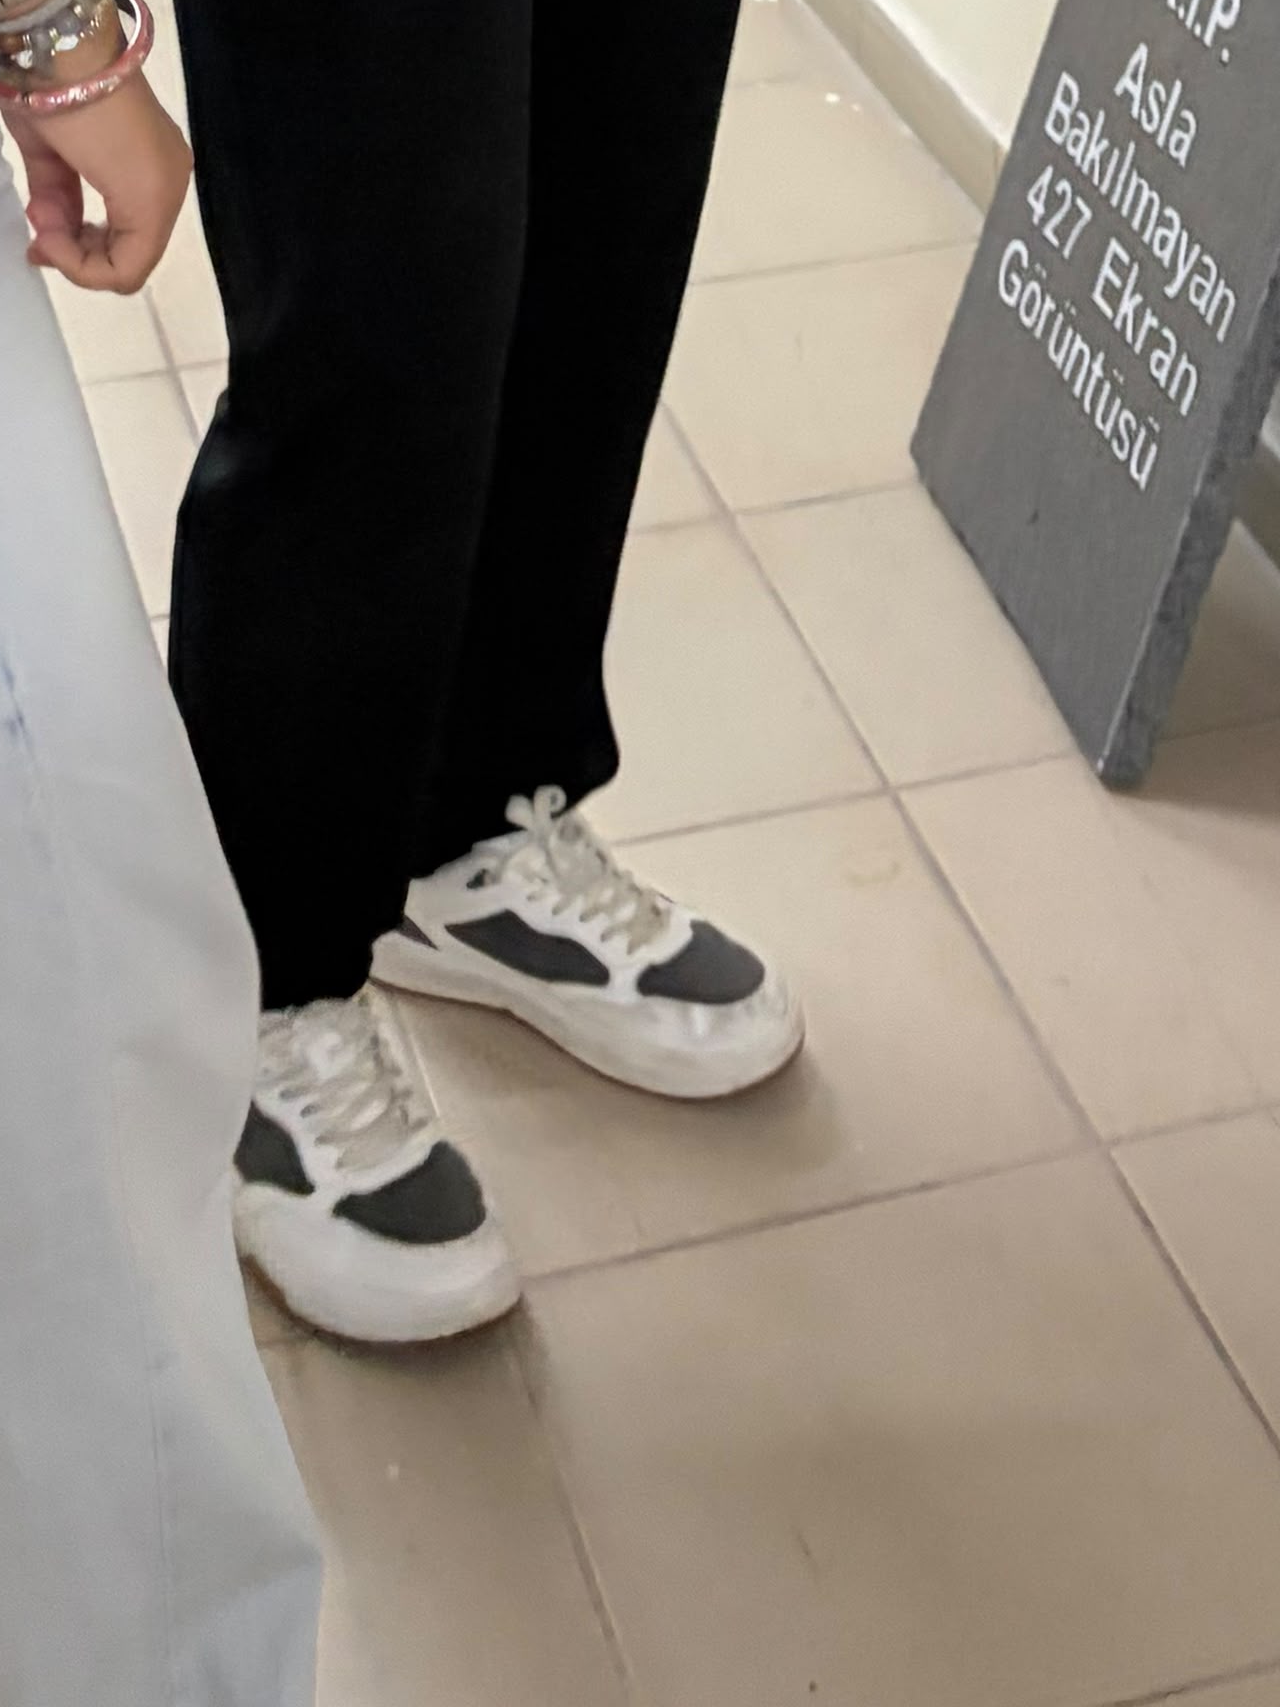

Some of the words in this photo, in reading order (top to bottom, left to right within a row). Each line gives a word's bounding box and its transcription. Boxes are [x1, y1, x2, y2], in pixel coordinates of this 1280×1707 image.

[1043, 71, 1239, 343] Bakılmayan
[1113, 41, 1198, 169] Asla
[997, 237, 1162, 491] Görüntüsü
[1026, 163, 1093, 260] 427
[1093, 237, 1200, 417] Ekran
